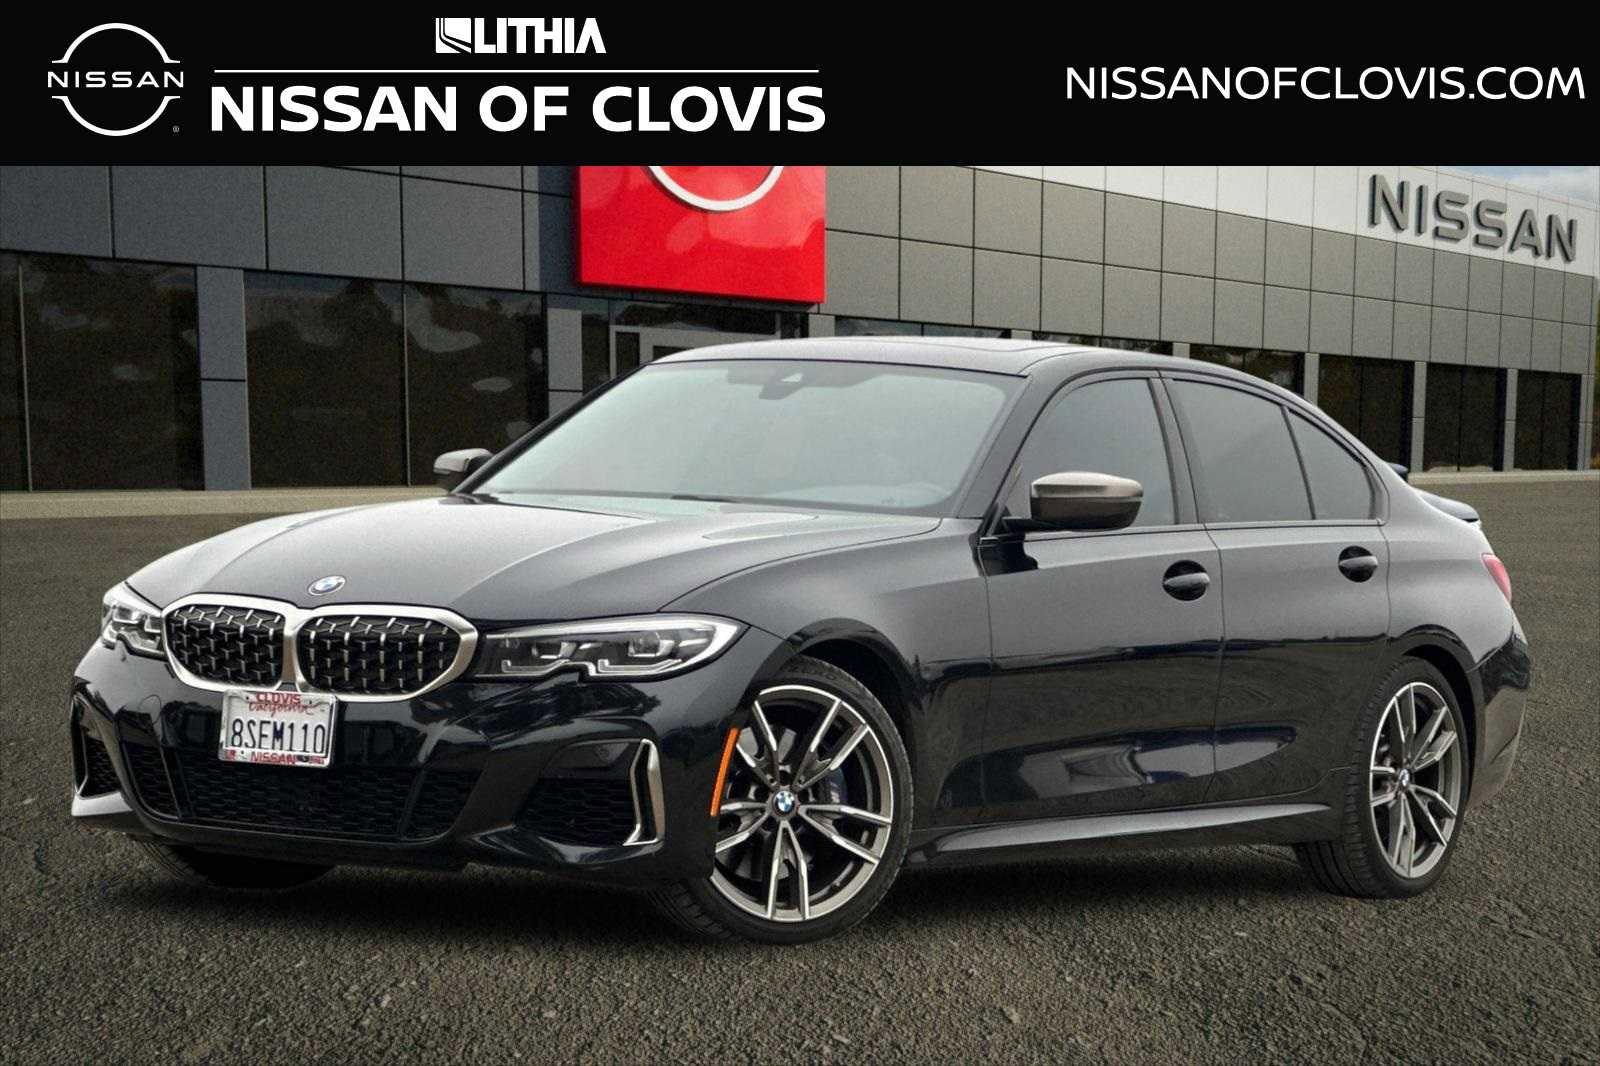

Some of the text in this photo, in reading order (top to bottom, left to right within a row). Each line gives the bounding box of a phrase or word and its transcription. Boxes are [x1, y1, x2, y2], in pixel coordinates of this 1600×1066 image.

[1368, 174, 1577, 263] NISSAN
[255, 691, 302, 704] CLOVIS
[231, 718, 326, 754] 8SEM110
[250, 751, 297, 765] NISSAN
